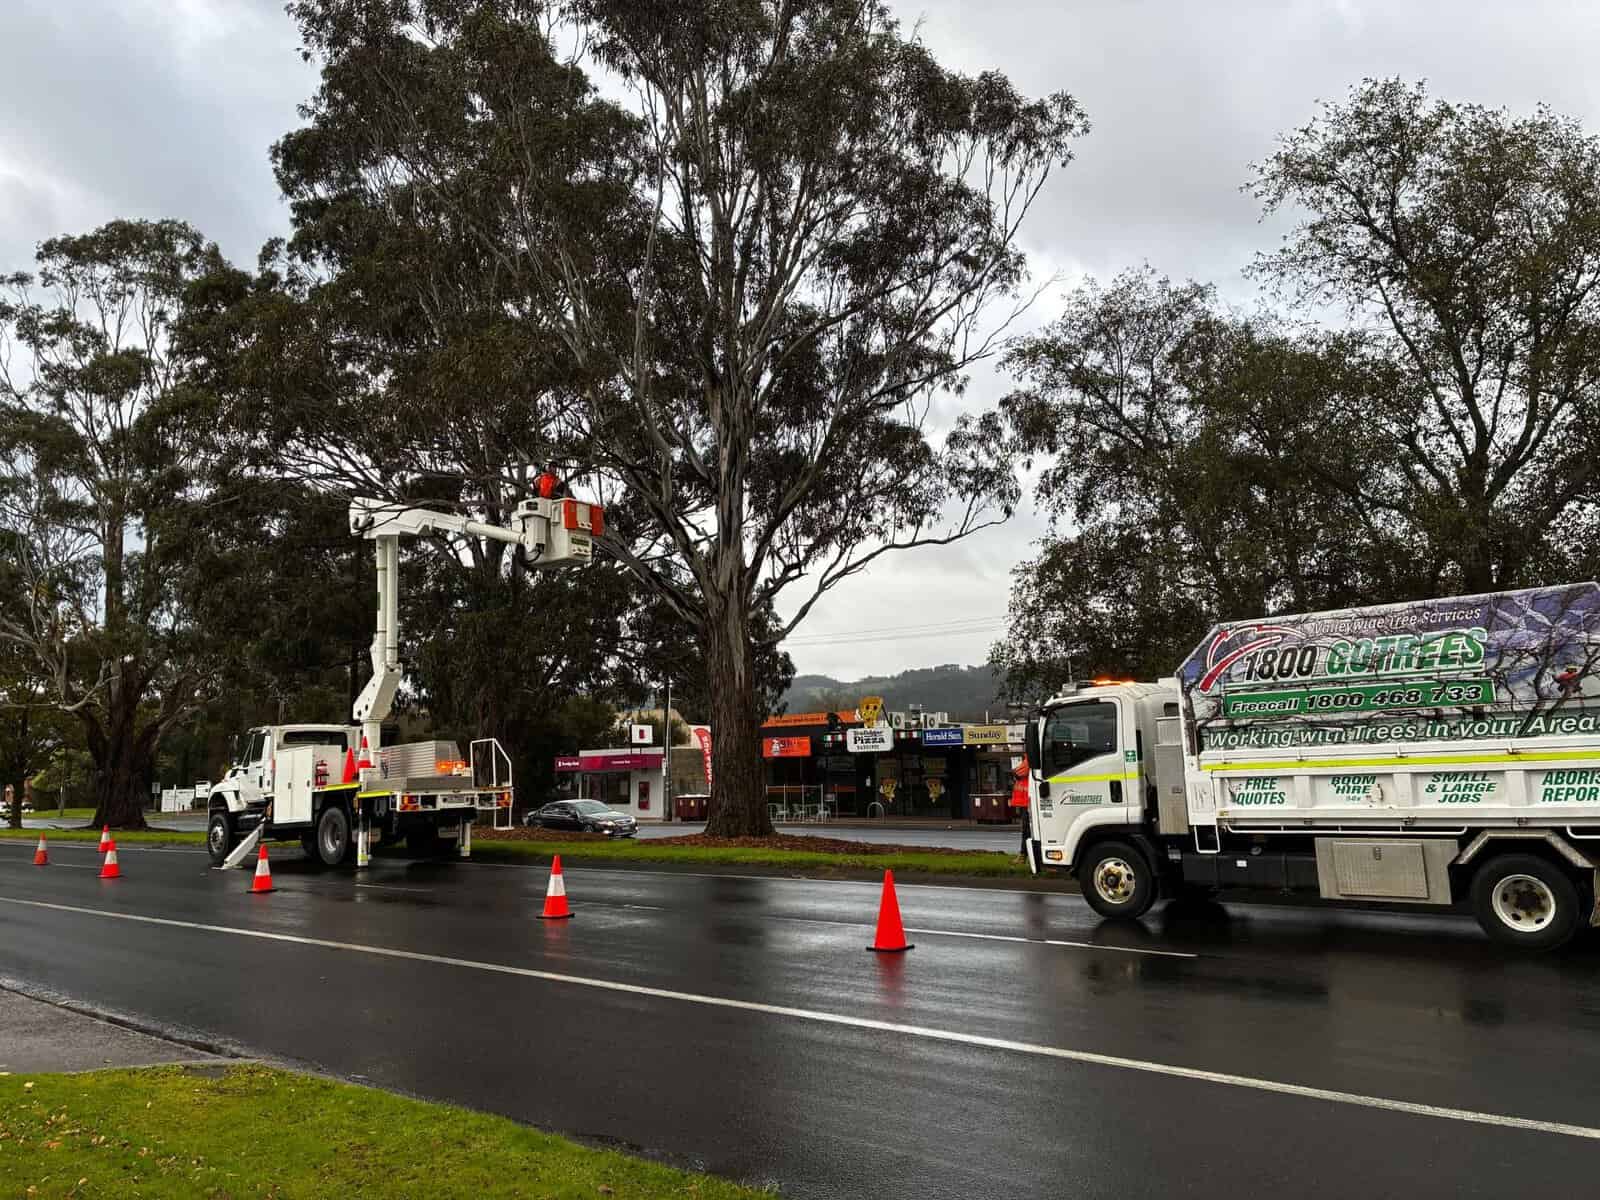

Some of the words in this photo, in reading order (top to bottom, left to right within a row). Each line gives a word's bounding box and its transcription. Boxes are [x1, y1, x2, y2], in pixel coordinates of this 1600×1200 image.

[1390, 614, 1417, 627] Tree
[1422, 608, 1481, 624] Services
[1244, 644, 1318, 681] 1800
[1326, 627, 1487, 675] GOTREES
[1230, 698, 1299, 714] Freecall
[1305, 691, 1365, 709] 1800
[1371, 688, 1422, 706] 468
[1431, 685, 1484, 703] 733
[968, 730, 1002, 741] Sunday
[1209, 728, 1294, 747] Working
[1352, 724, 1417, 740] Trees
[1425, 719, 1449, 737] in
[1459, 718, 1520, 737] your
[853, 735, 885, 745] Pizza
[1244, 776, 1279, 790] FREE
[1331, 775, 1376, 786] BOOM
[1431, 771, 1490, 783] SMALL
[1336, 784, 1372, 795] HIRE
[1425, 783, 1438, 793] &
[1441, 782, 1498, 793] LARGE
[1236, 791, 1287, 806] QUOTES
[1437, 793, 1482, 803] JOBS
